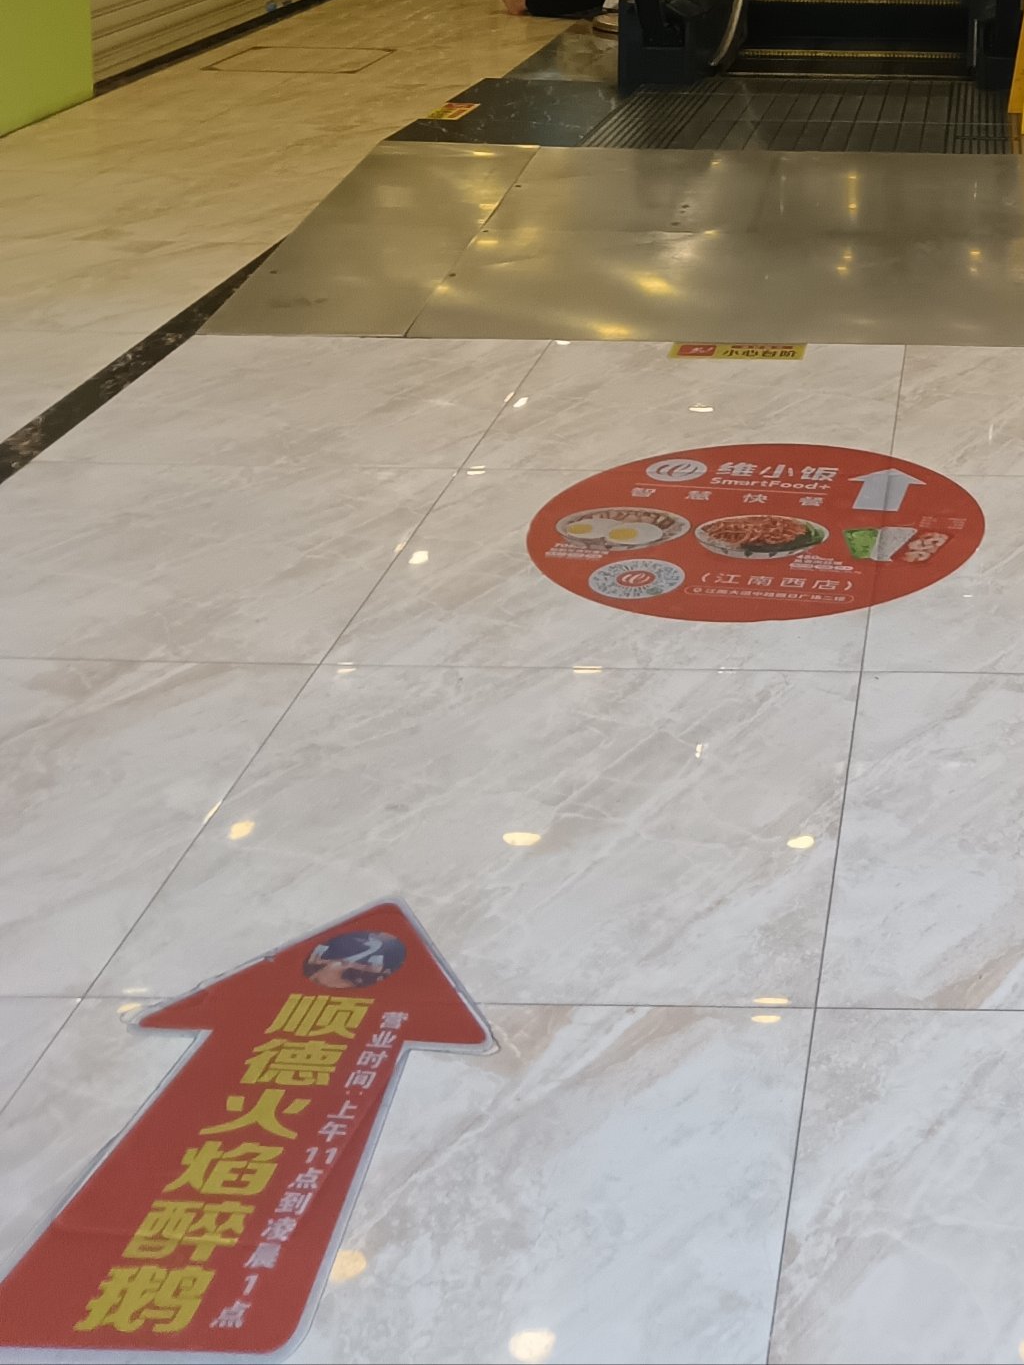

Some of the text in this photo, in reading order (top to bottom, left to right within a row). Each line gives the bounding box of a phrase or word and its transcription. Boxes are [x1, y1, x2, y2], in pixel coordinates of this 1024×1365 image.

[715, 462, 839, 482] 维小饭
[72, 993, 376, 1333] 顺德火焰醉鹅
